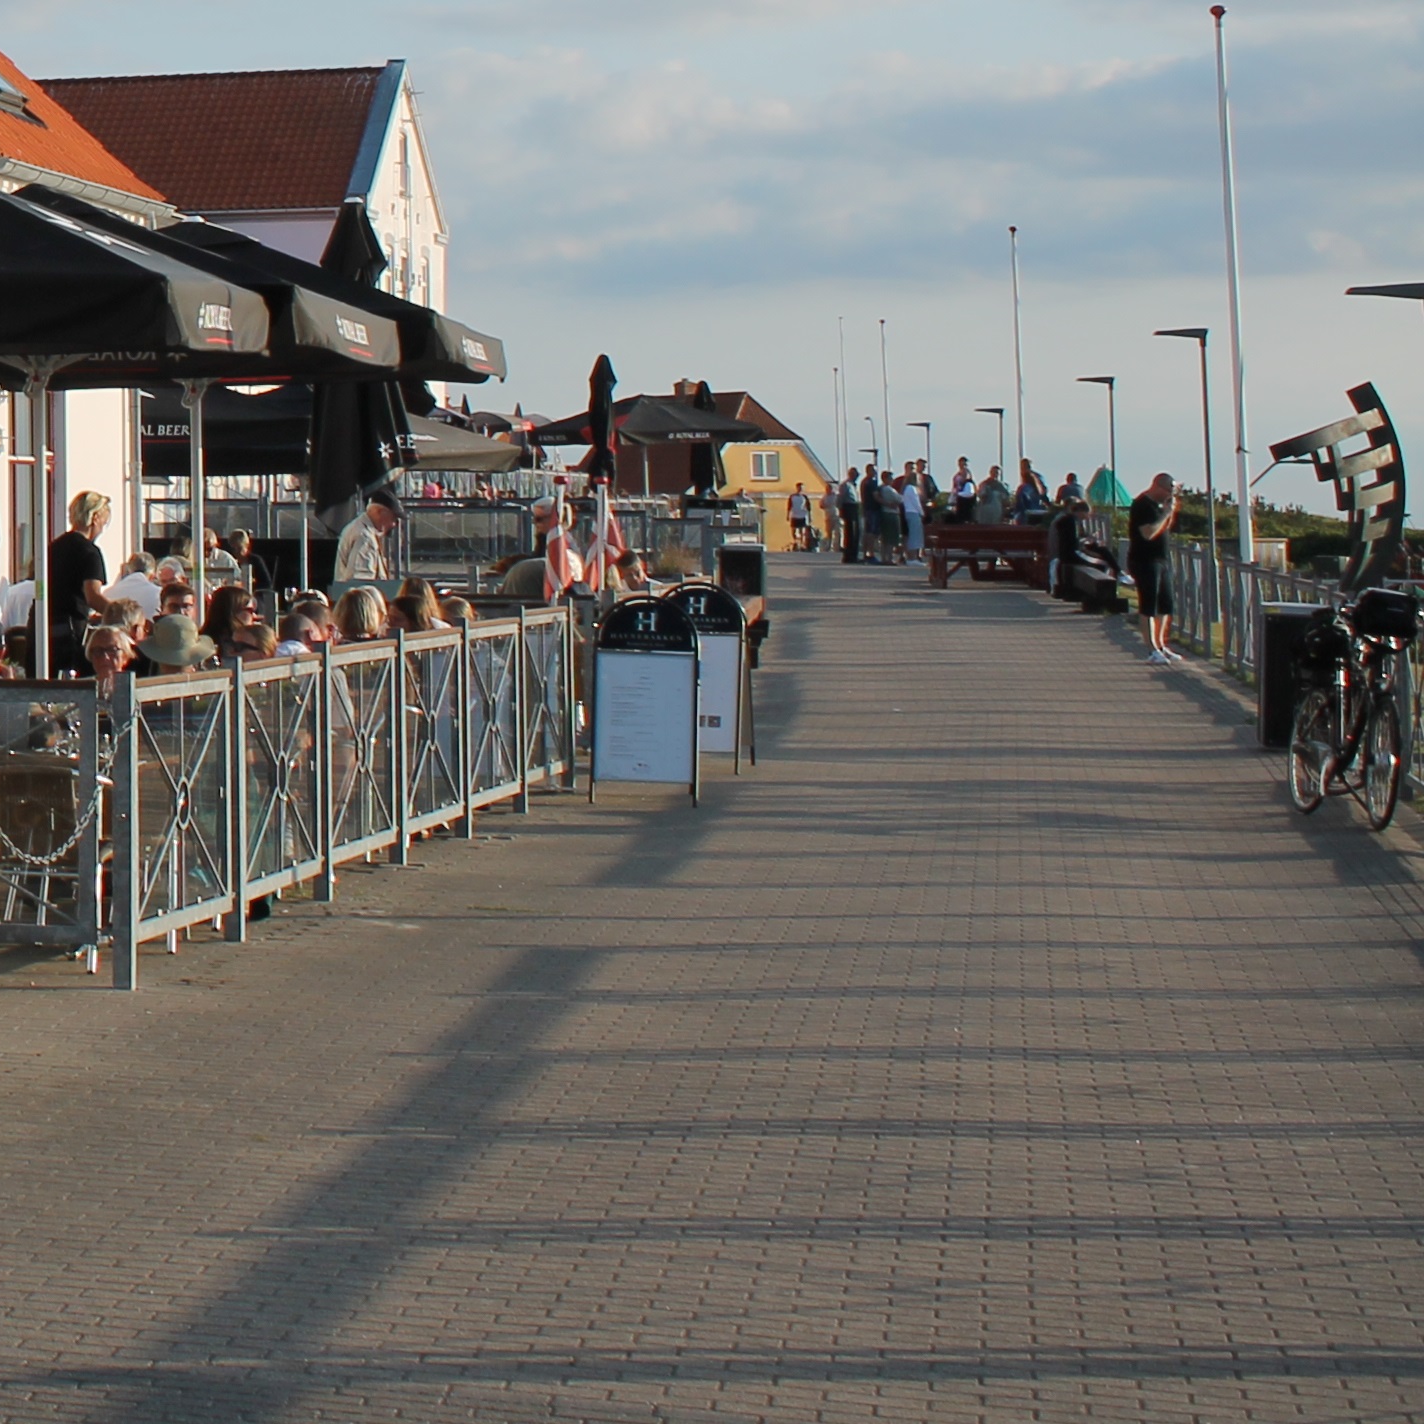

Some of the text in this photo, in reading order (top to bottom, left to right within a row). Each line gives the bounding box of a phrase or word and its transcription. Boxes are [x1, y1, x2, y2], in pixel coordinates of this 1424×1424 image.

[157, 424, 191, 437] BEER
[688, 596, 706, 615] H
[637, 611, 657, 632] H
